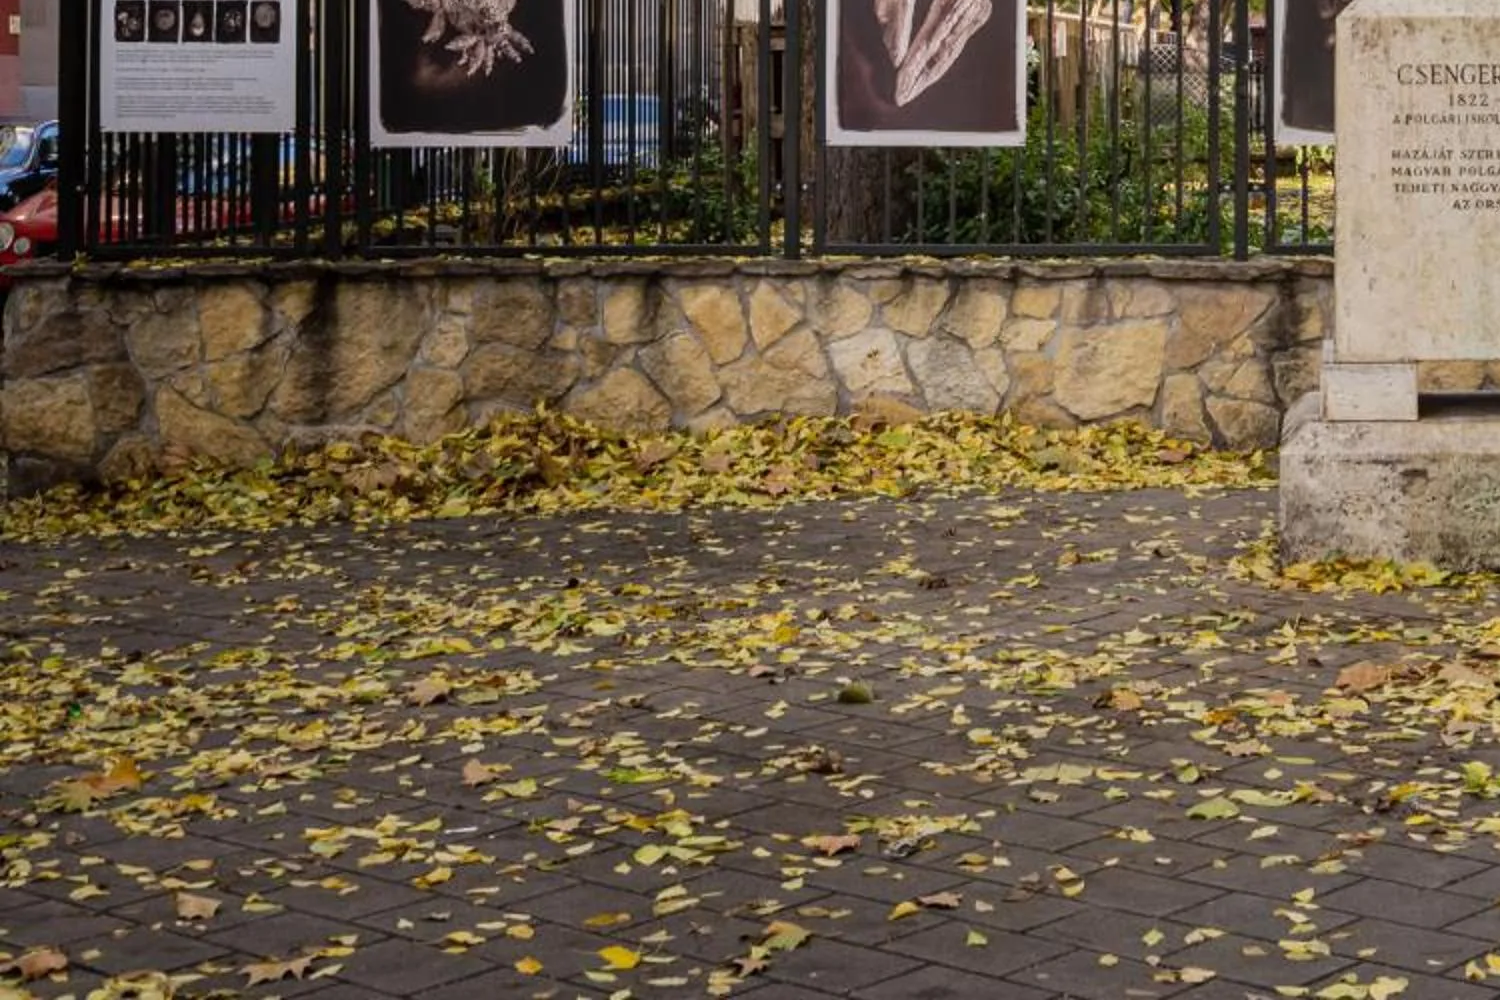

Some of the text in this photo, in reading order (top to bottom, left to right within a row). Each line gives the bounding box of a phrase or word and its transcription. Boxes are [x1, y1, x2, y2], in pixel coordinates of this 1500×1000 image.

[1449, 93, 1489, 107] 1822
[1392, 113, 1401, 125] A
[1391, 145, 1454, 160] HAZÁJÁT
[1391, 166, 1451, 177] MAGYAR
[1393, 182, 1445, 194] TEHETI
[1453, 199, 1471, 210] AZ
